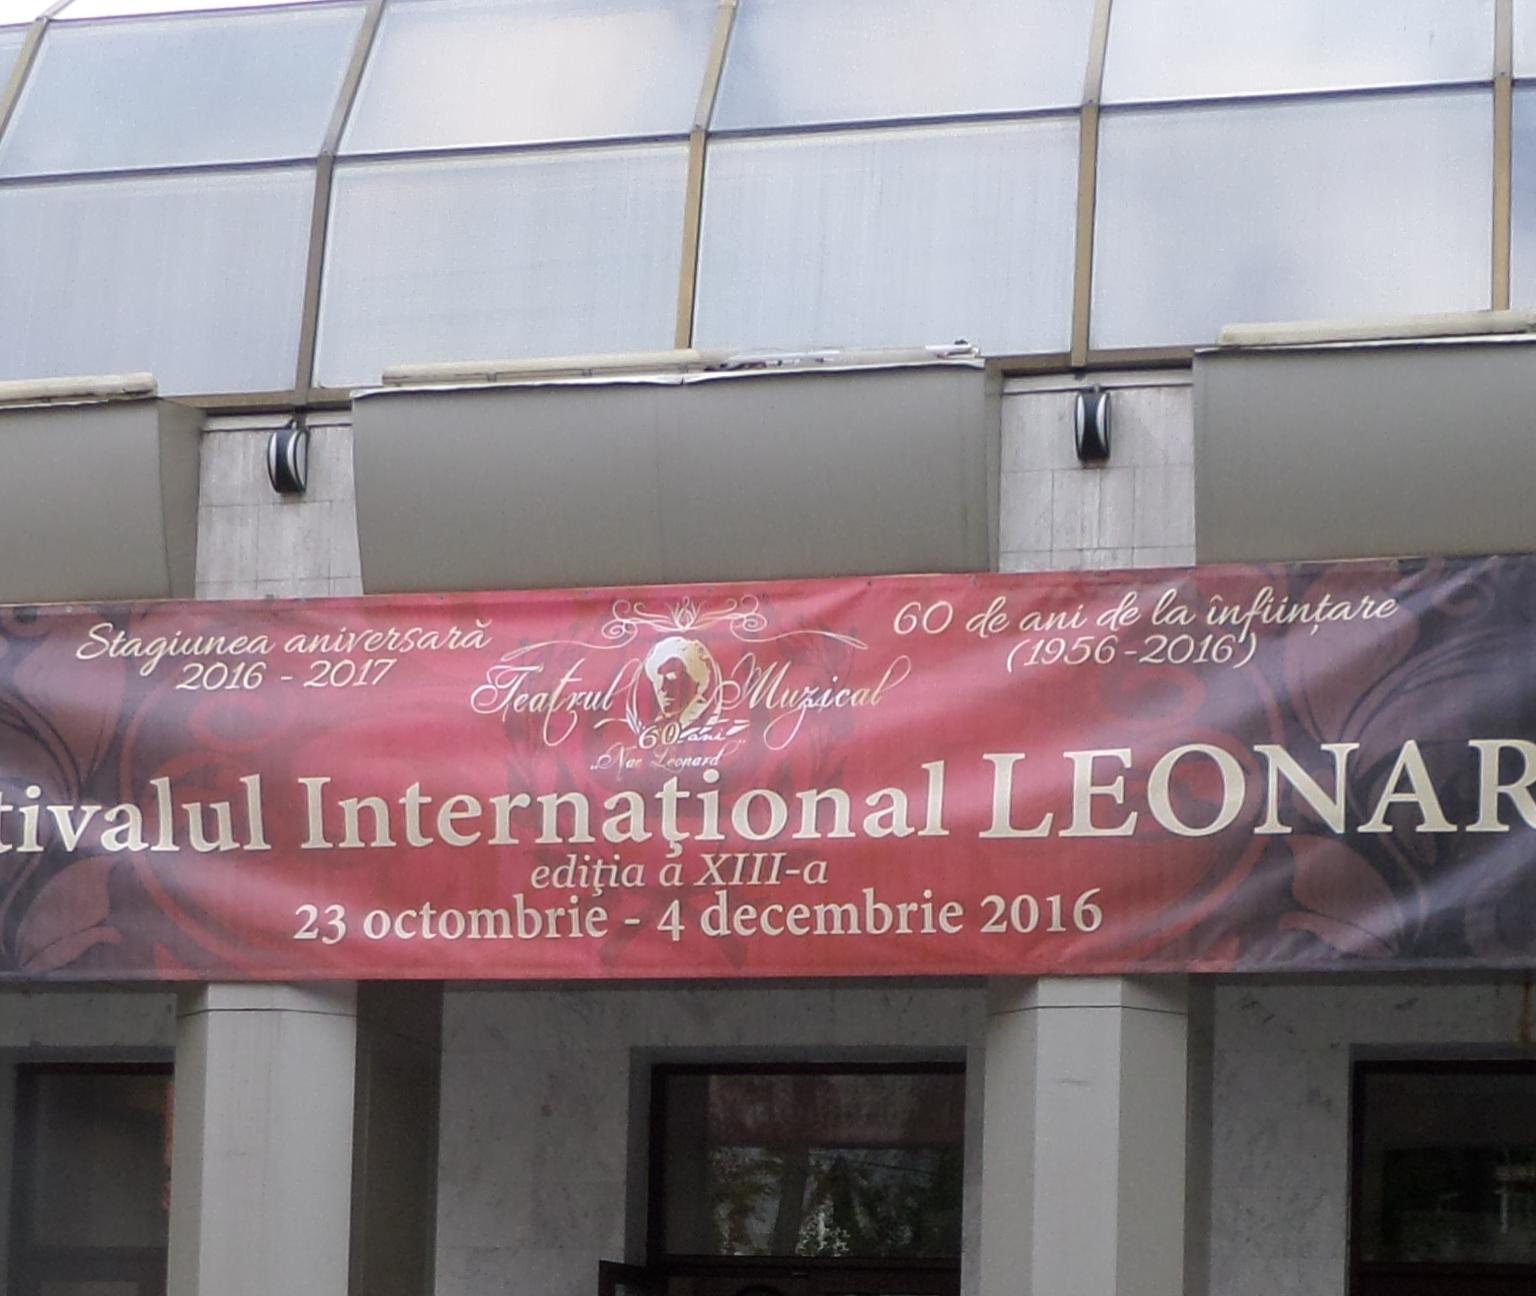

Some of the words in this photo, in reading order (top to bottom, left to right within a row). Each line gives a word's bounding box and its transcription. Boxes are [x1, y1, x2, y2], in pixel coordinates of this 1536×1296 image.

[894, 601, 954, 635] 60
[966, 597, 1009, 638] de
[1020, 602, 1085, 633] ani
[1096, 591, 1141, 633] de
[1151, 587, 1196, 627] la
[75, 622, 275, 677] Stagiunea
[284, 618, 493, 655] aniversară
[175, 660, 268, 691] 2016
[303, 658, 398, 689] 2017
[470, 657, 645, 747] Teatrul
[718, 653, 912, 751] Muzical
[659, 863, 684, 888] a
[694, 853, 829, 887] XIII-a
[293, 903, 348, 945] 23
[363, 894, 608, 941] octombrie
[657, 899, 685, 942] 4
[701, 889, 965, 937] decembrie
[980, 887, 1104, 934] 2016
